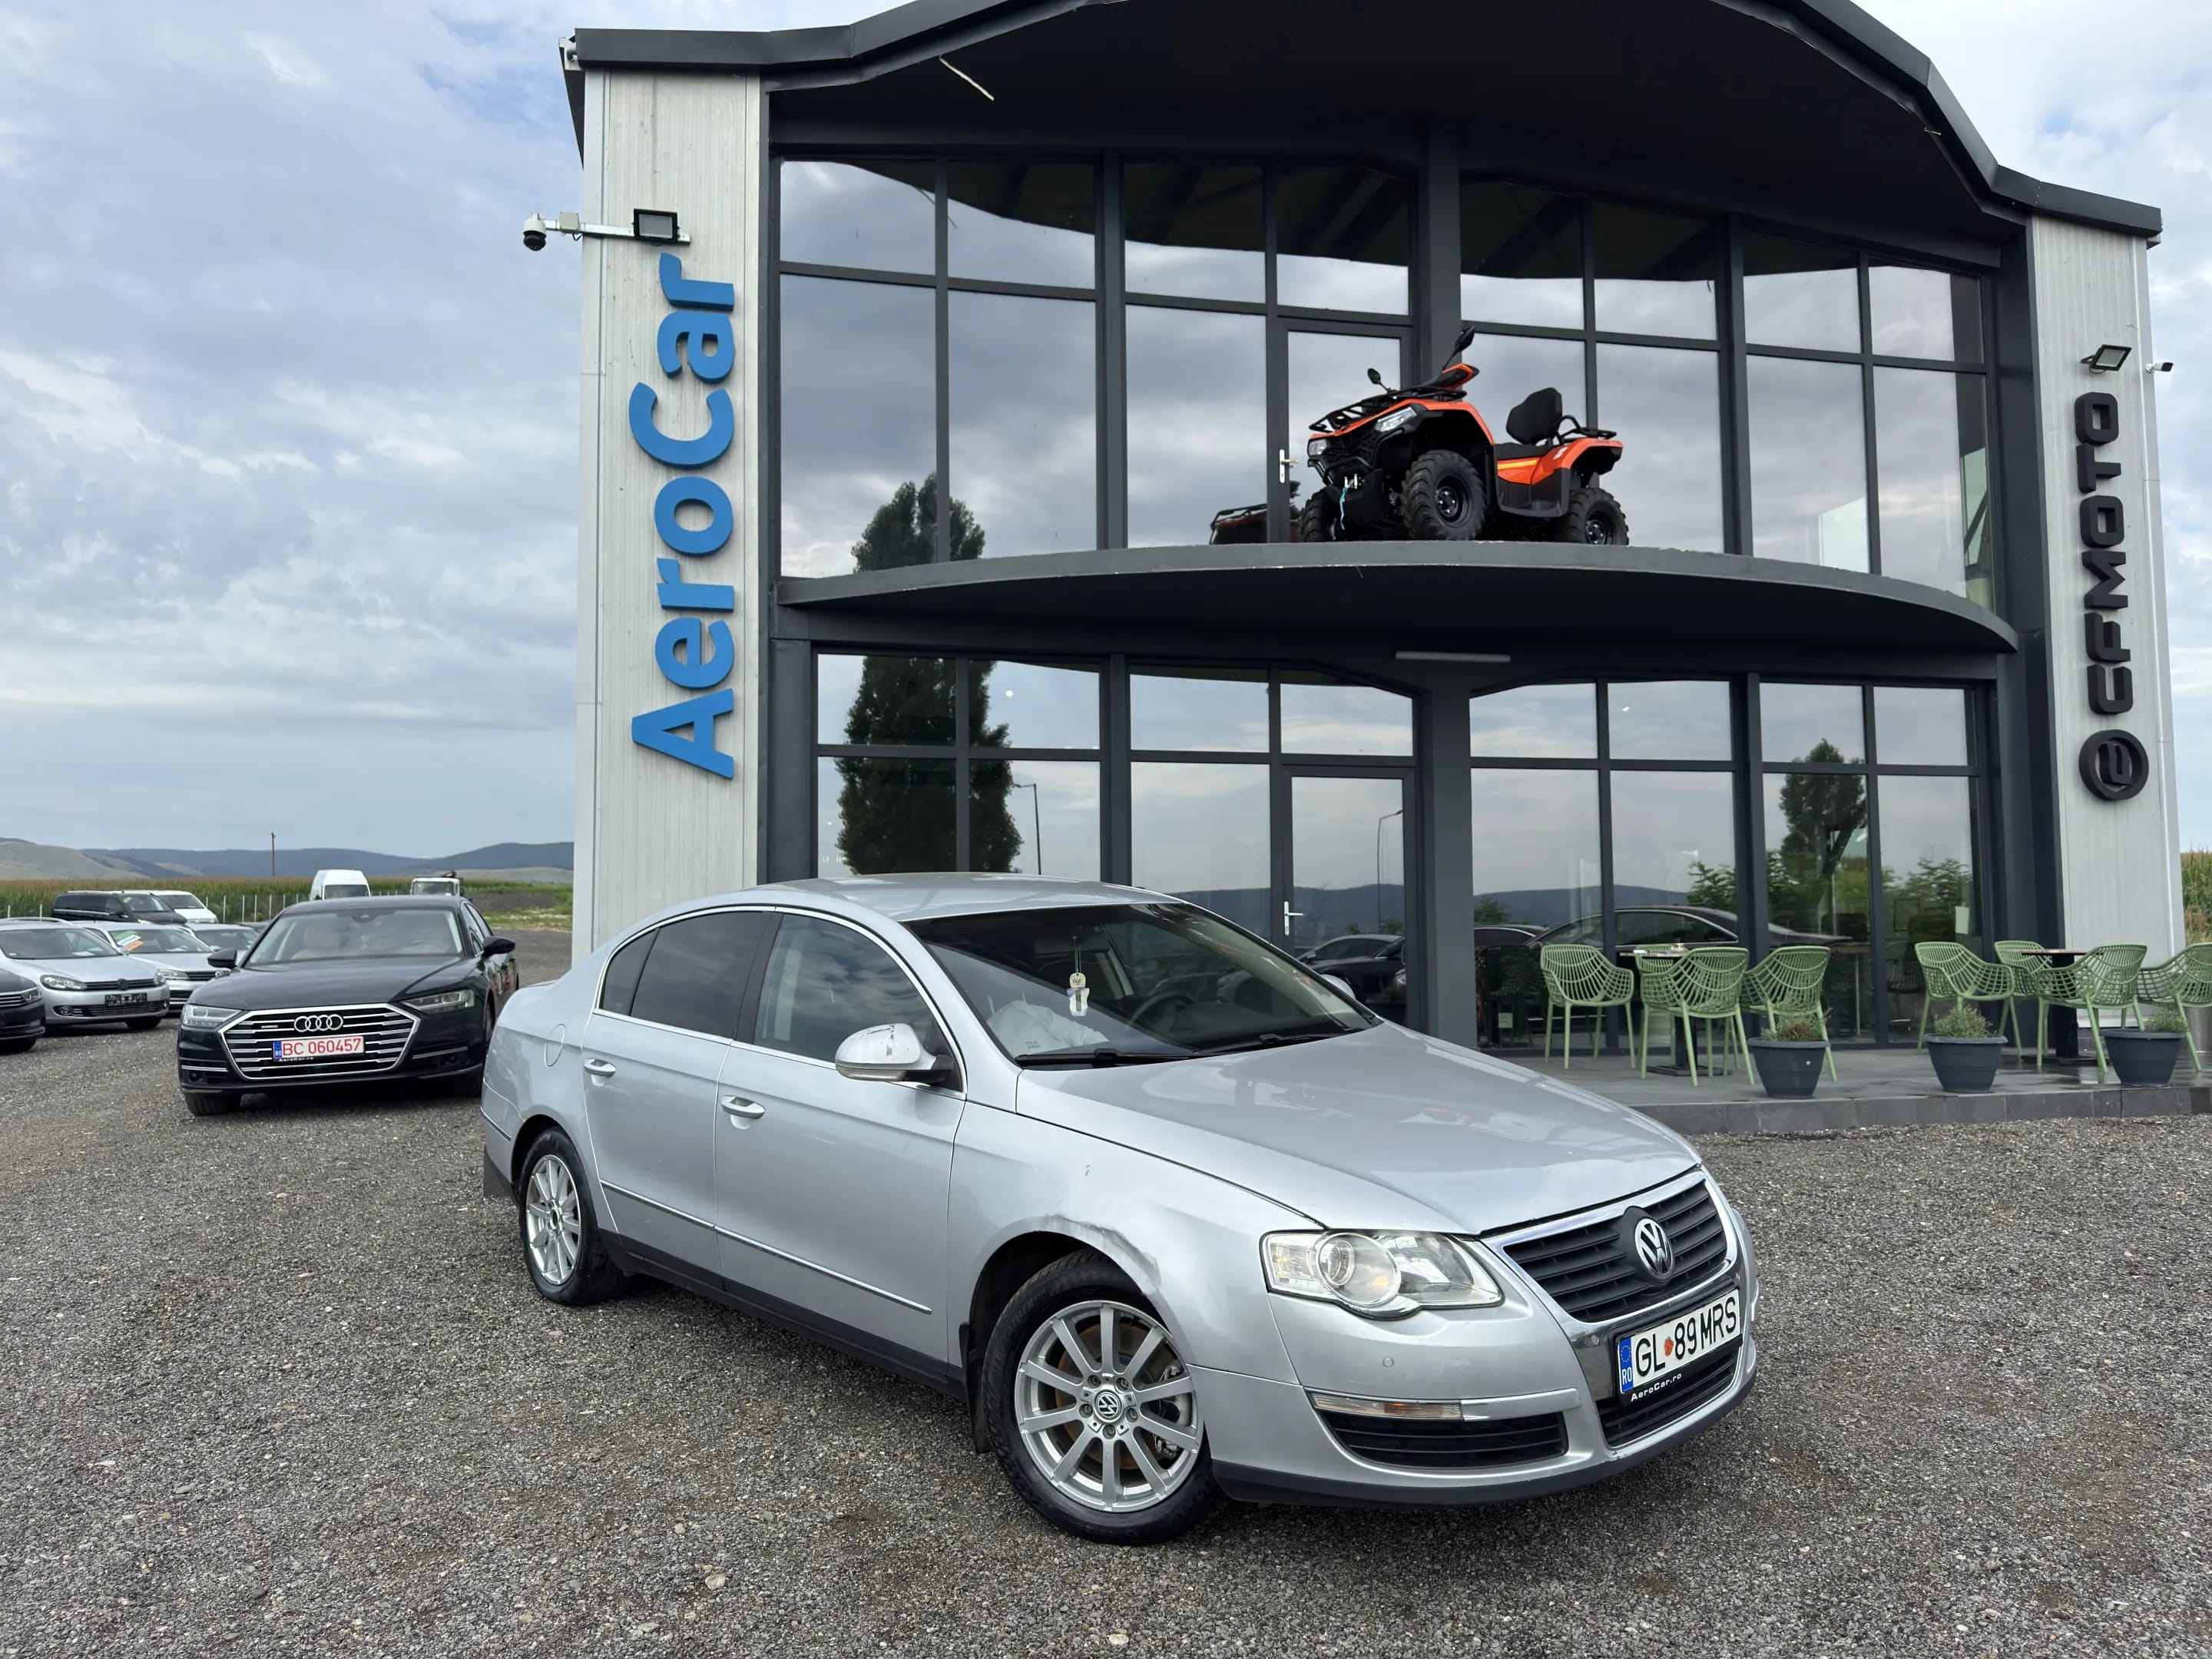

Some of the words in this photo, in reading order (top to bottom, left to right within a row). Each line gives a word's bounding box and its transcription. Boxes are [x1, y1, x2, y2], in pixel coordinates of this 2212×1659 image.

[629, 253, 734, 779] AeroCar
[2075, 392, 2134, 715] CFMOTO
[283, 1042, 303, 1056] BC
[308, 1038, 361, 1054] 060457
[1635, 1333, 1666, 1377] GL
[1674, 1316, 1697, 1360] 89
[1700, 1296, 1737, 1350] MRS
[1622, 1366, 1633, 1386] RO
[1631, 1373, 1682, 1402] AeroCar.ro
